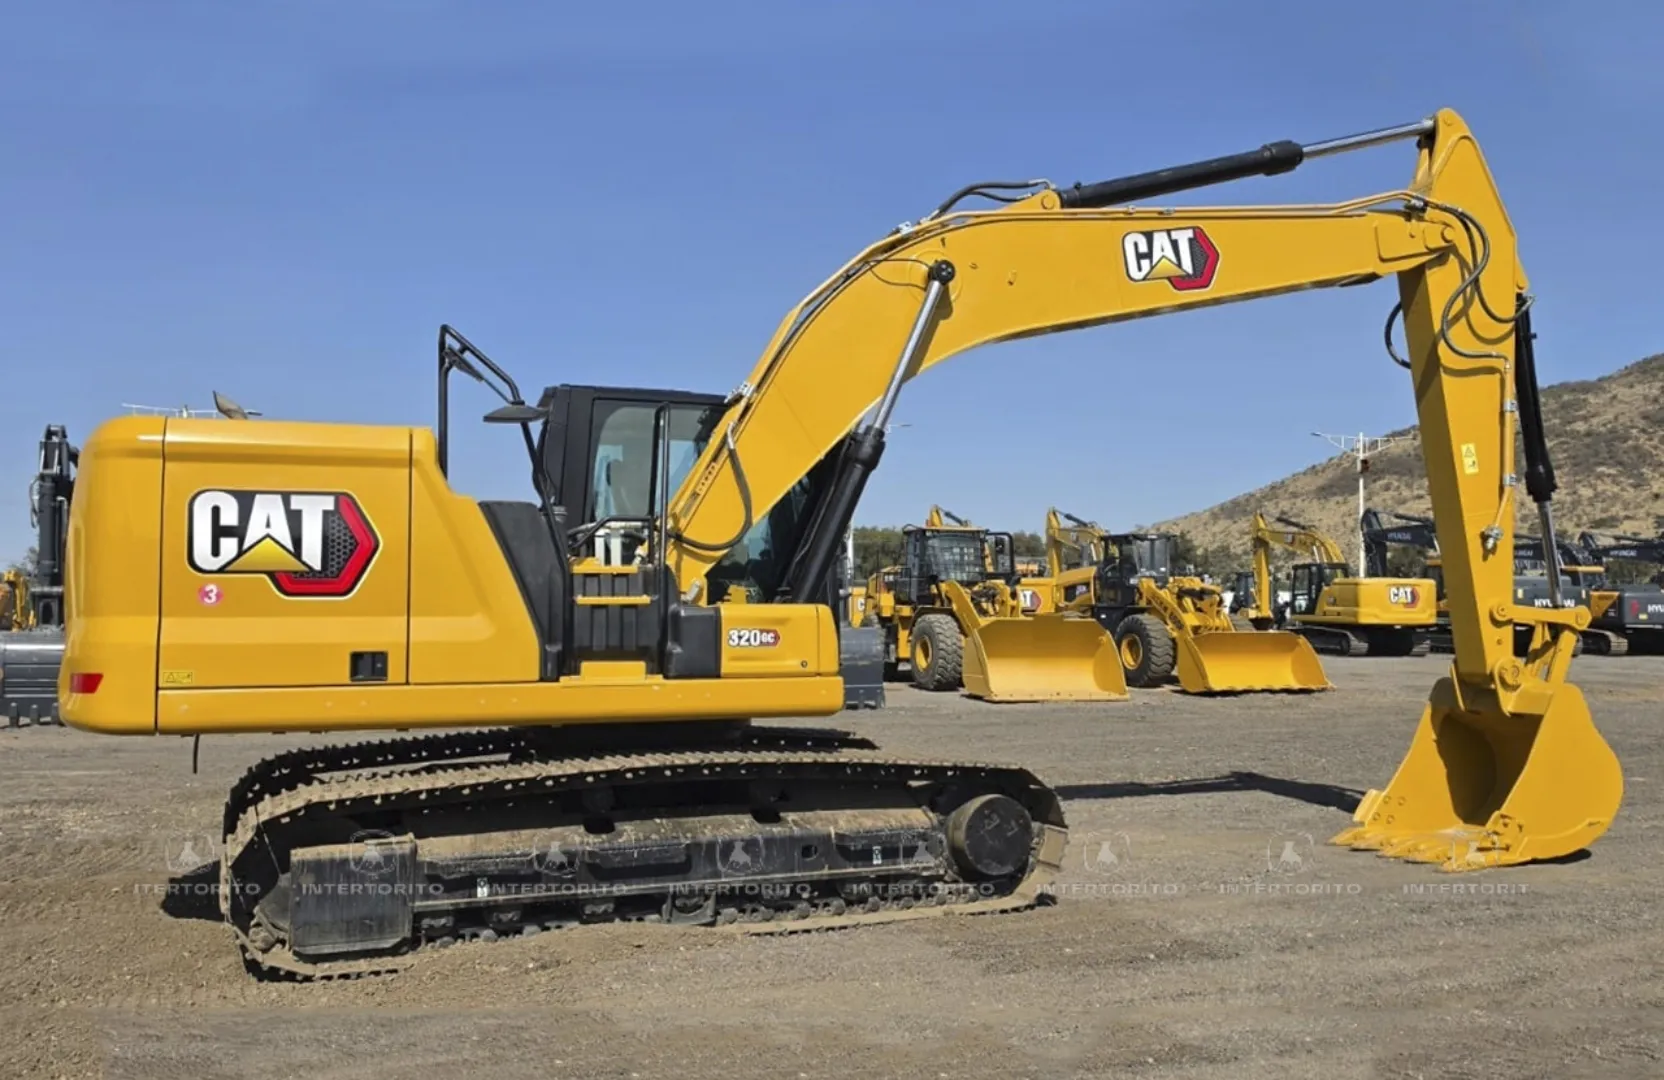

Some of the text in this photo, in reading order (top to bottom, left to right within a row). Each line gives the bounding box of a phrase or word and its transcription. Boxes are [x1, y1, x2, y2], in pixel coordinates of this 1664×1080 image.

[1123, 229, 1194, 281] CAT
[193, 491, 335, 571] CAT
[203, 584, 217, 604] 3
[1390, 587, 1413, 604] CAT
[728, 629, 775, 647] 320 GC
